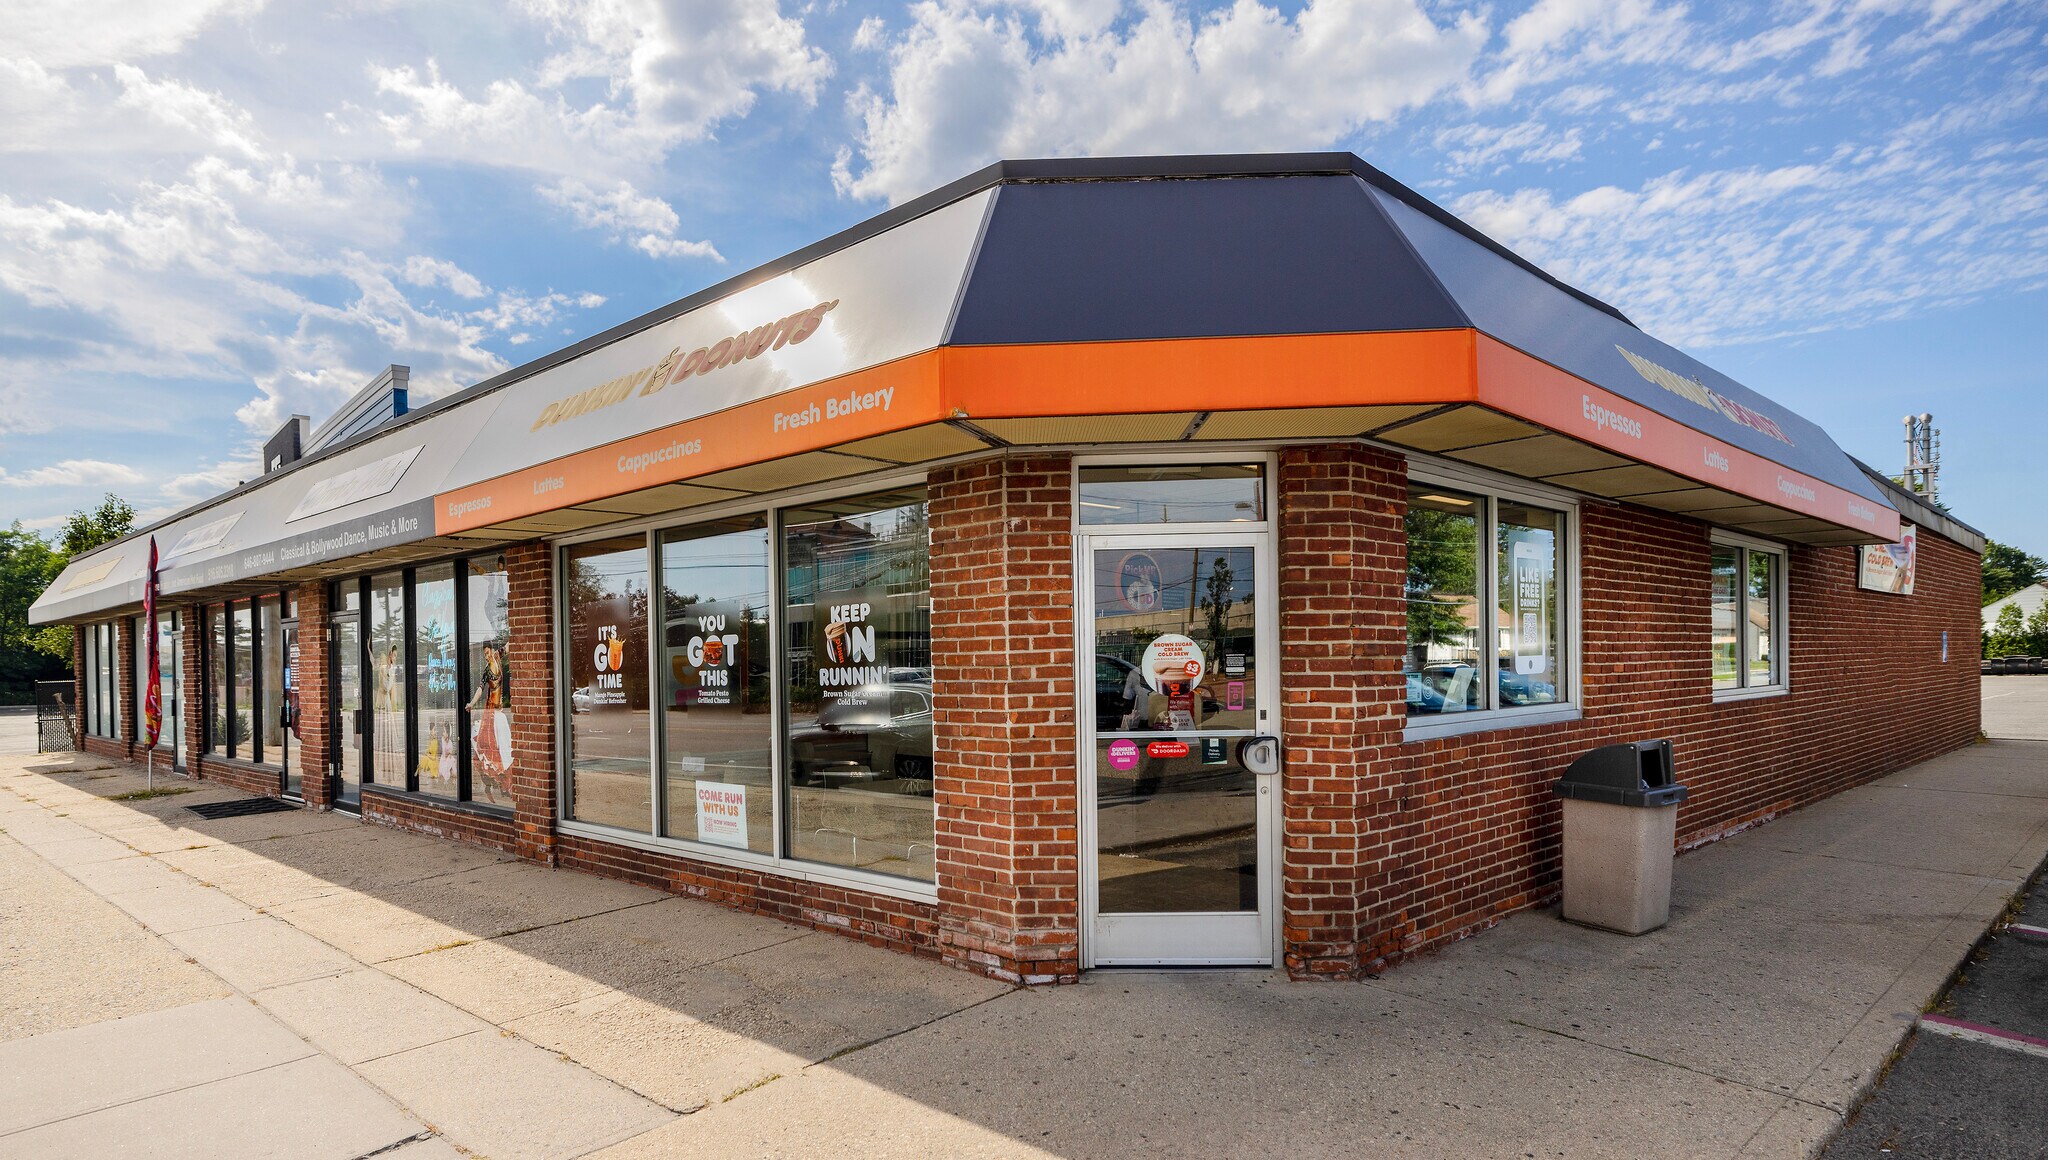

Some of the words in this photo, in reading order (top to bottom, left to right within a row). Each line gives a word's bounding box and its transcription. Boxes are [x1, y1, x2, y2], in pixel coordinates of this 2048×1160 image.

[672, 301, 831, 384] DONUTS
[774, 403, 820, 432] Fresh
[826, 387, 894, 419] Bakery
[1582, 395, 1642, 439] Espressos
[617, 438, 701, 473] Cappuccinos
[1703, 447, 1729, 472] Lattes
[533, 476, 564, 495] Lattes
[1777, 475, 1815, 502] Cappuccinos
[448, 496, 491, 518] Espressos
[280, 543, 305, 561] Classical
[305, 542, 311, 555] &
[311, 533, 344, 556] Bollywood
[344, 529, 367, 546] Dance,
[368, 524, 389, 540] Music
[391, 519, 397, 534] &
[398, 517, 418, 533] More
[1520, 566, 1539, 583] LIKE
[1520, 583, 1539, 598] FREE
[1520, 599, 1540, 607] DRINKS?
[830, 602, 871, 624] KEEP
[698, 614, 725, 632] YOU
[598, 625, 617, 641] IT'S
[819, 665, 887, 686] RUNNIN'
[1186, 662, 1199, 673] $3
[597, 674, 622, 689] TIME
[698, 670, 728, 686] THIS
[823, 690, 843, 698] Brown
[698, 789, 722, 802] COME
[724, 792, 743, 804] RUN
[703, 802, 725, 815] WITH
[728, 804, 739, 817] US
